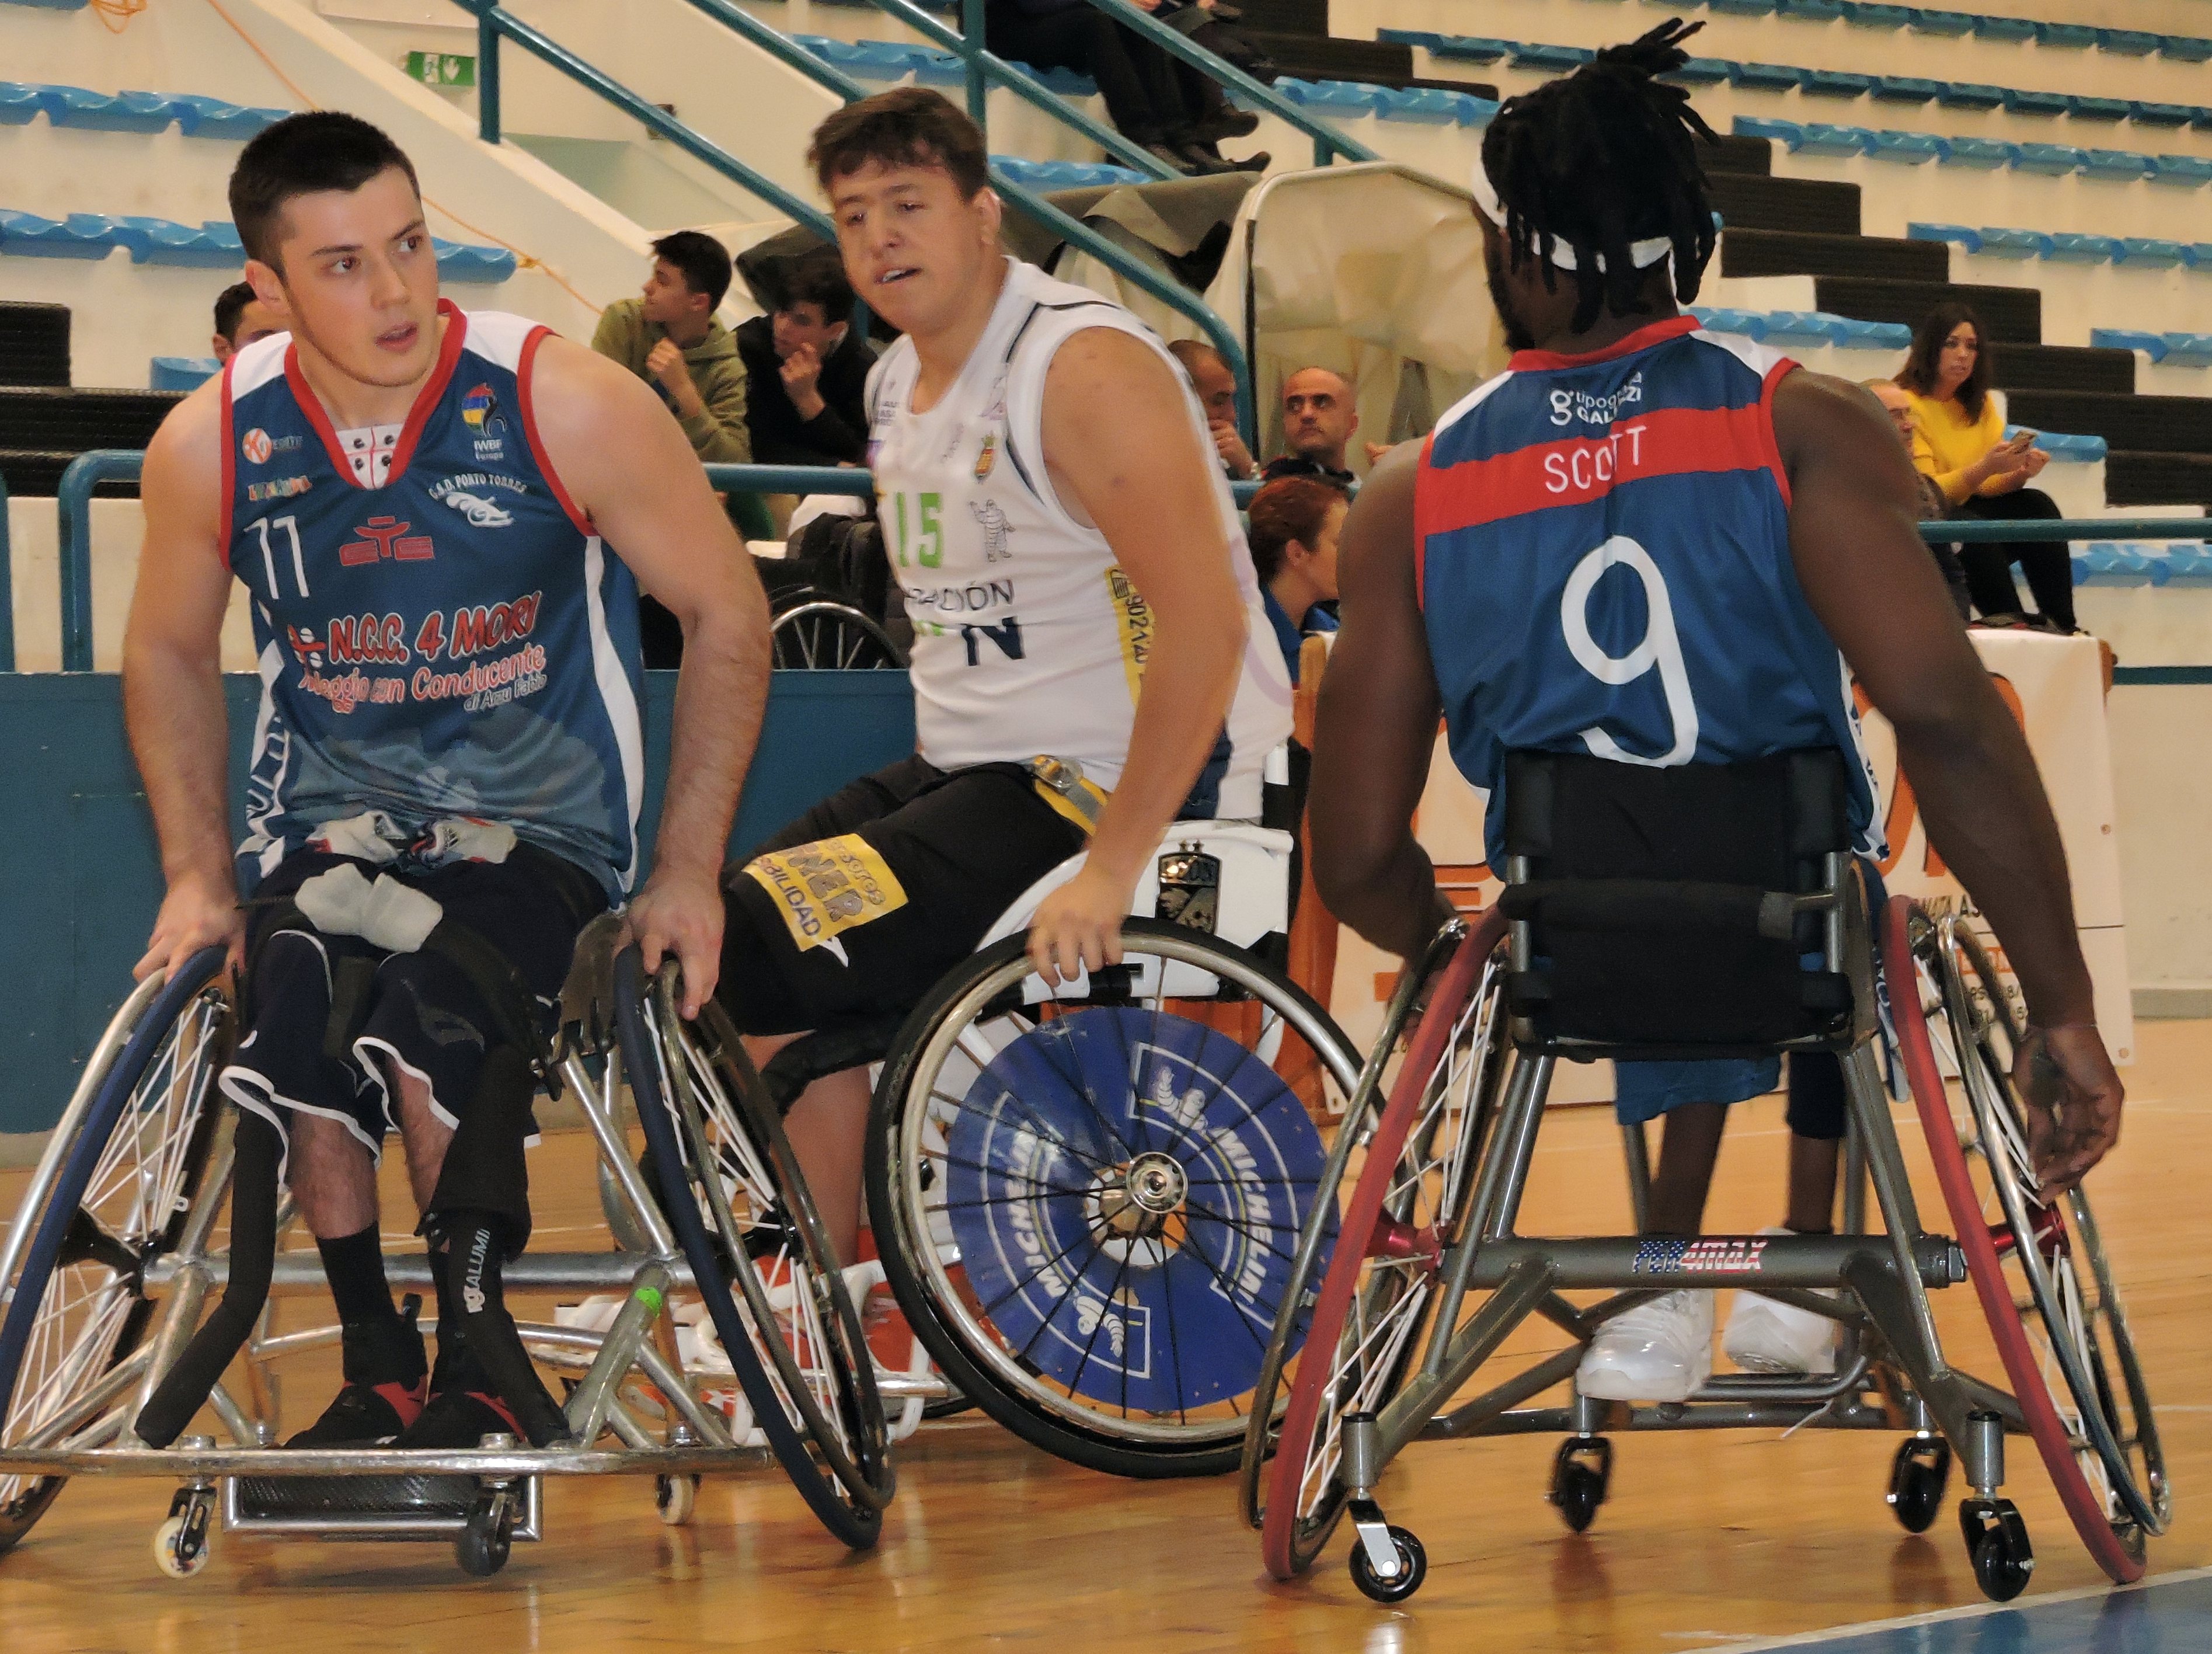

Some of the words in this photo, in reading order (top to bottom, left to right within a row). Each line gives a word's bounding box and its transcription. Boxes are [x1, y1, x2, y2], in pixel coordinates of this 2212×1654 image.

[455, 473, 486, 489] PORTO
[1544, 426, 1647, 493] SCOTT
[896, 492, 942, 569] 15
[414, 610, 447, 663] 4
[448, 590, 542, 659] MORI
[1561, 535, 1699, 768] 9
[412, 642, 547, 701] Conducente
[1208, 1127, 1273, 1304] MICHELIN
